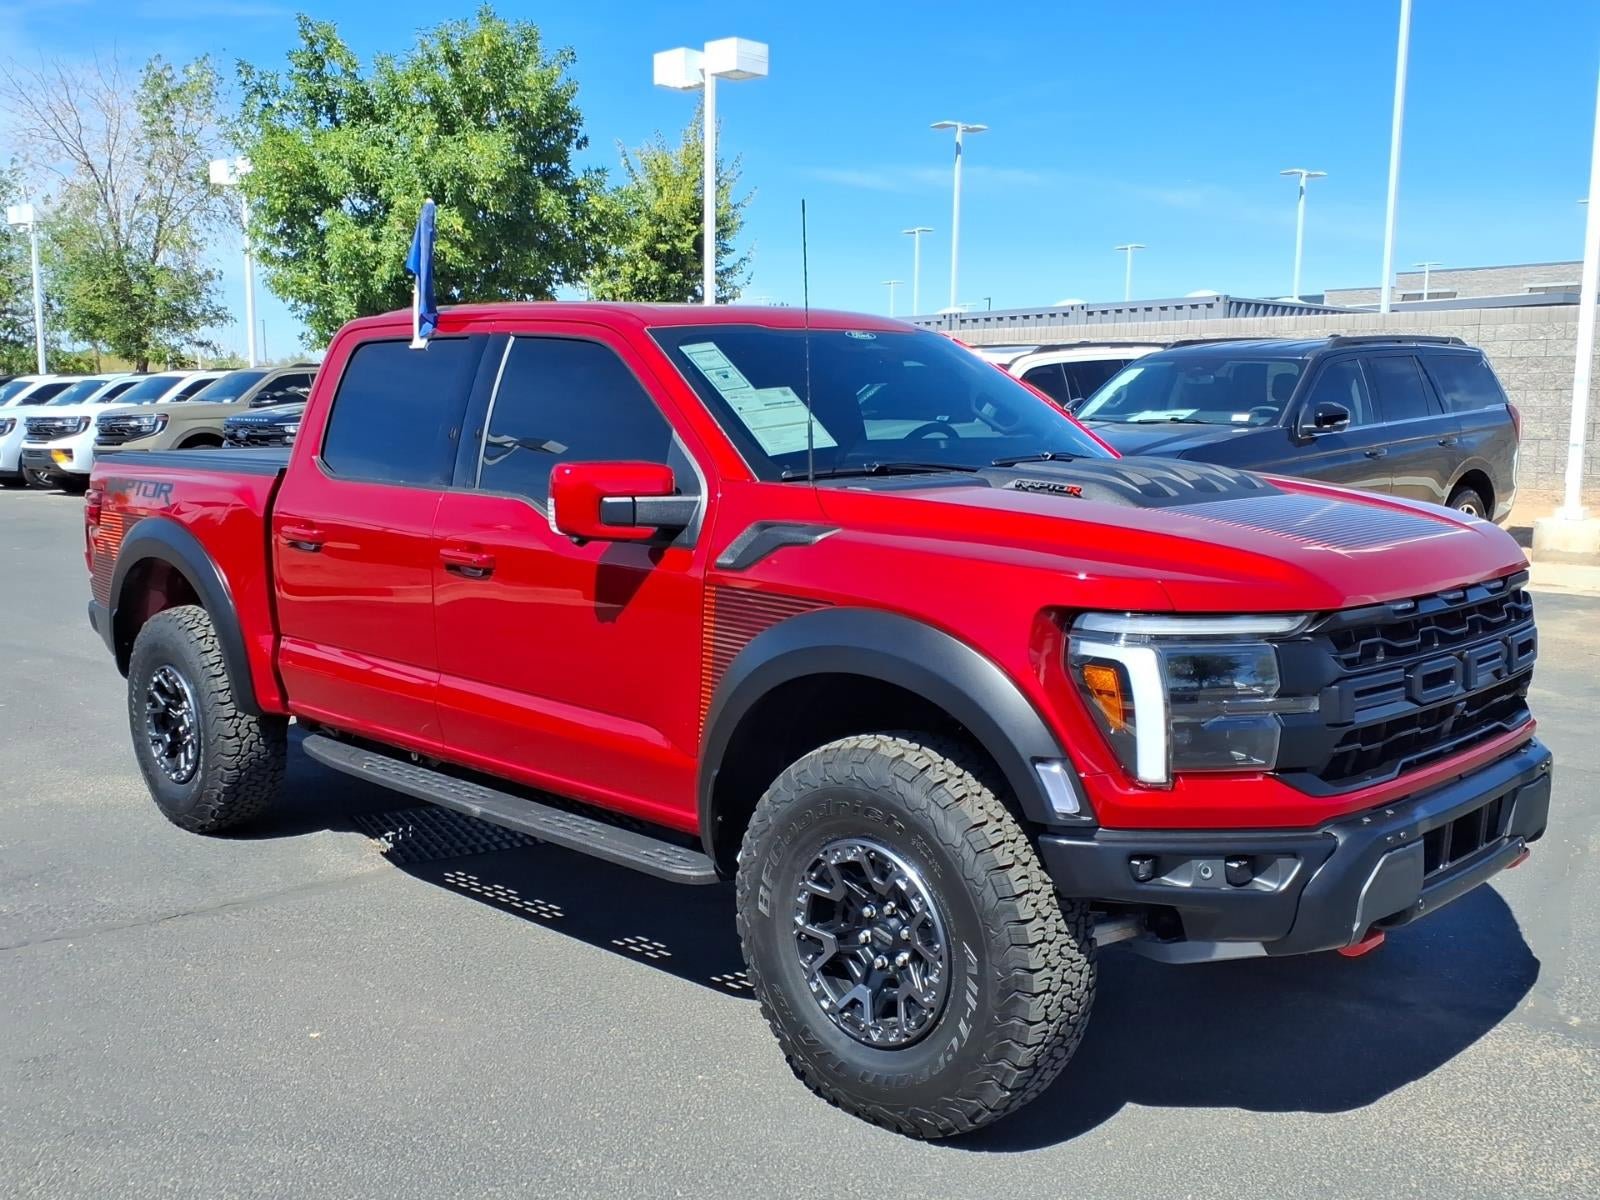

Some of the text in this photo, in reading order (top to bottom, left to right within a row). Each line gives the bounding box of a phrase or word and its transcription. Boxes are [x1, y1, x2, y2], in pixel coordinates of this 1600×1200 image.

[1014, 479, 1083, 497] RAPTOR
[1320, 627, 1538, 726] FORD
[758, 798, 906, 918] BFGoodrich
